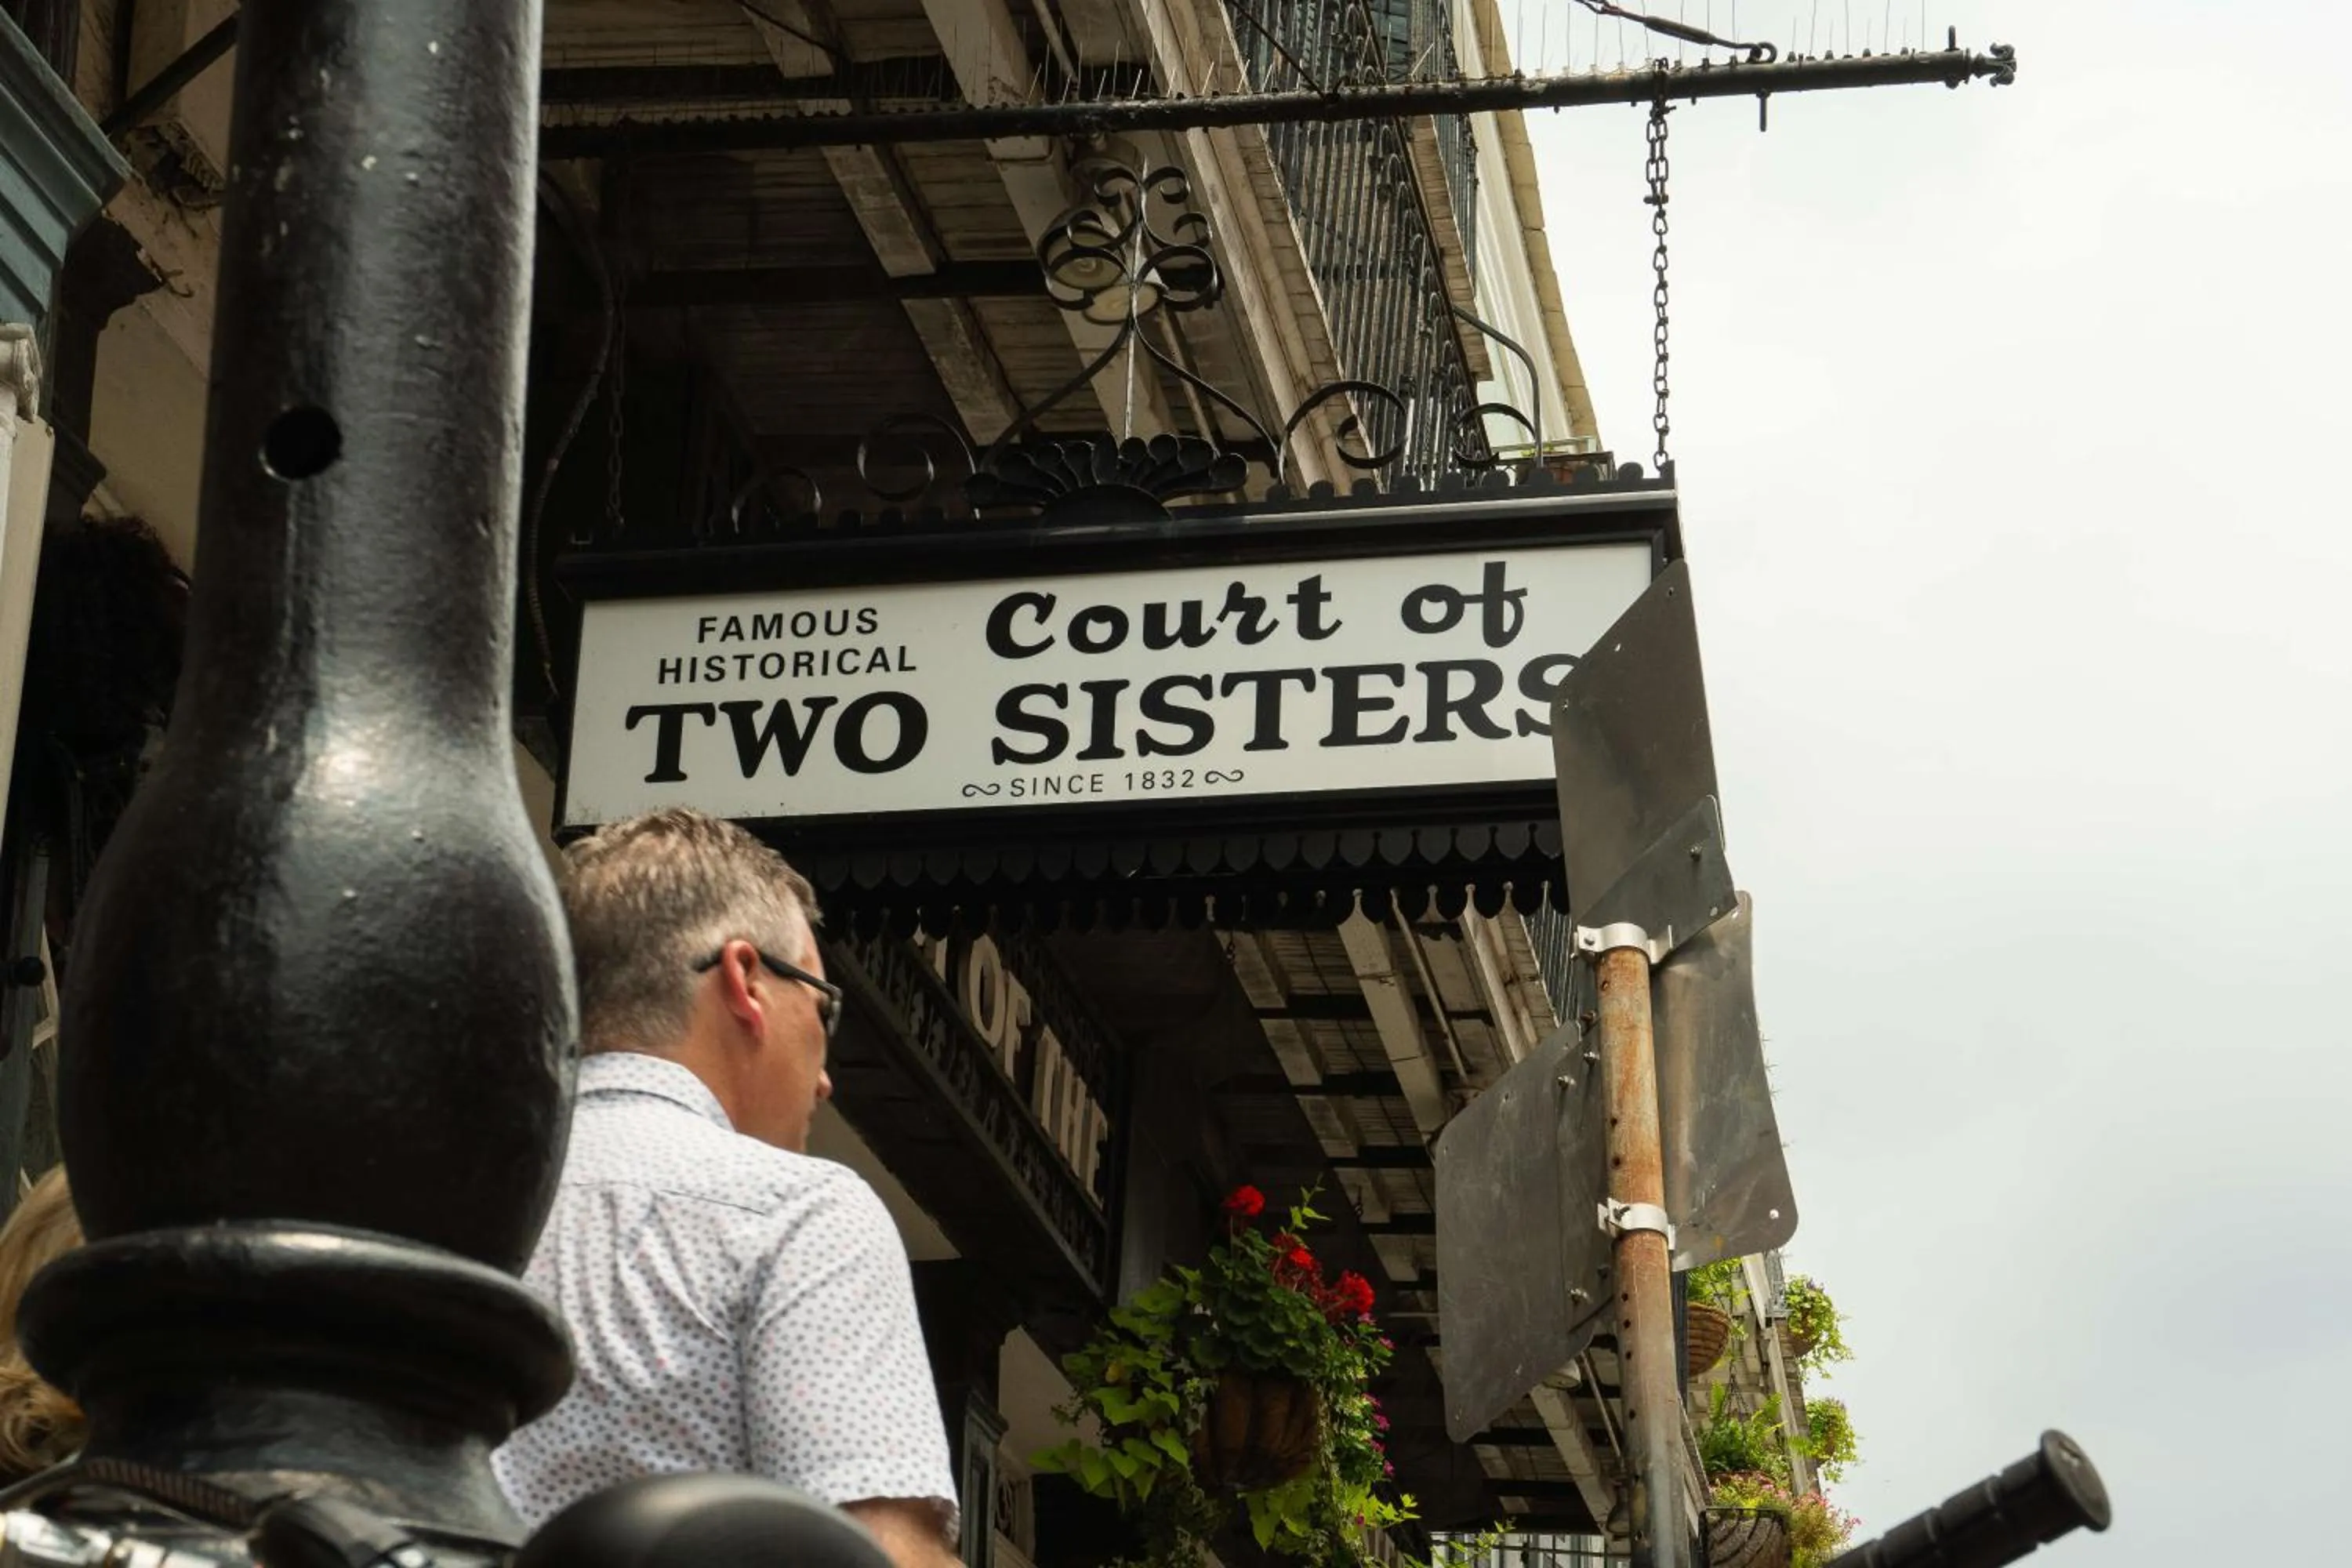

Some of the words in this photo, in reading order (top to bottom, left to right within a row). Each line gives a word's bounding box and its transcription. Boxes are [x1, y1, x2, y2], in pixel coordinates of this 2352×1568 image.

[697, 607, 879, 644] FAMOUS
[985, 574, 1343, 659] Court
[1401, 561, 1528, 648] of
[658, 645, 917, 684] HISTORICAL
[625, 691, 929, 784] TWO
[1009, 773, 1105, 798] SINCE
[1124, 769, 1196, 792] 1832
[966, 933, 1031, 1083] OF
[1036, 1024, 1109, 1211] THE
